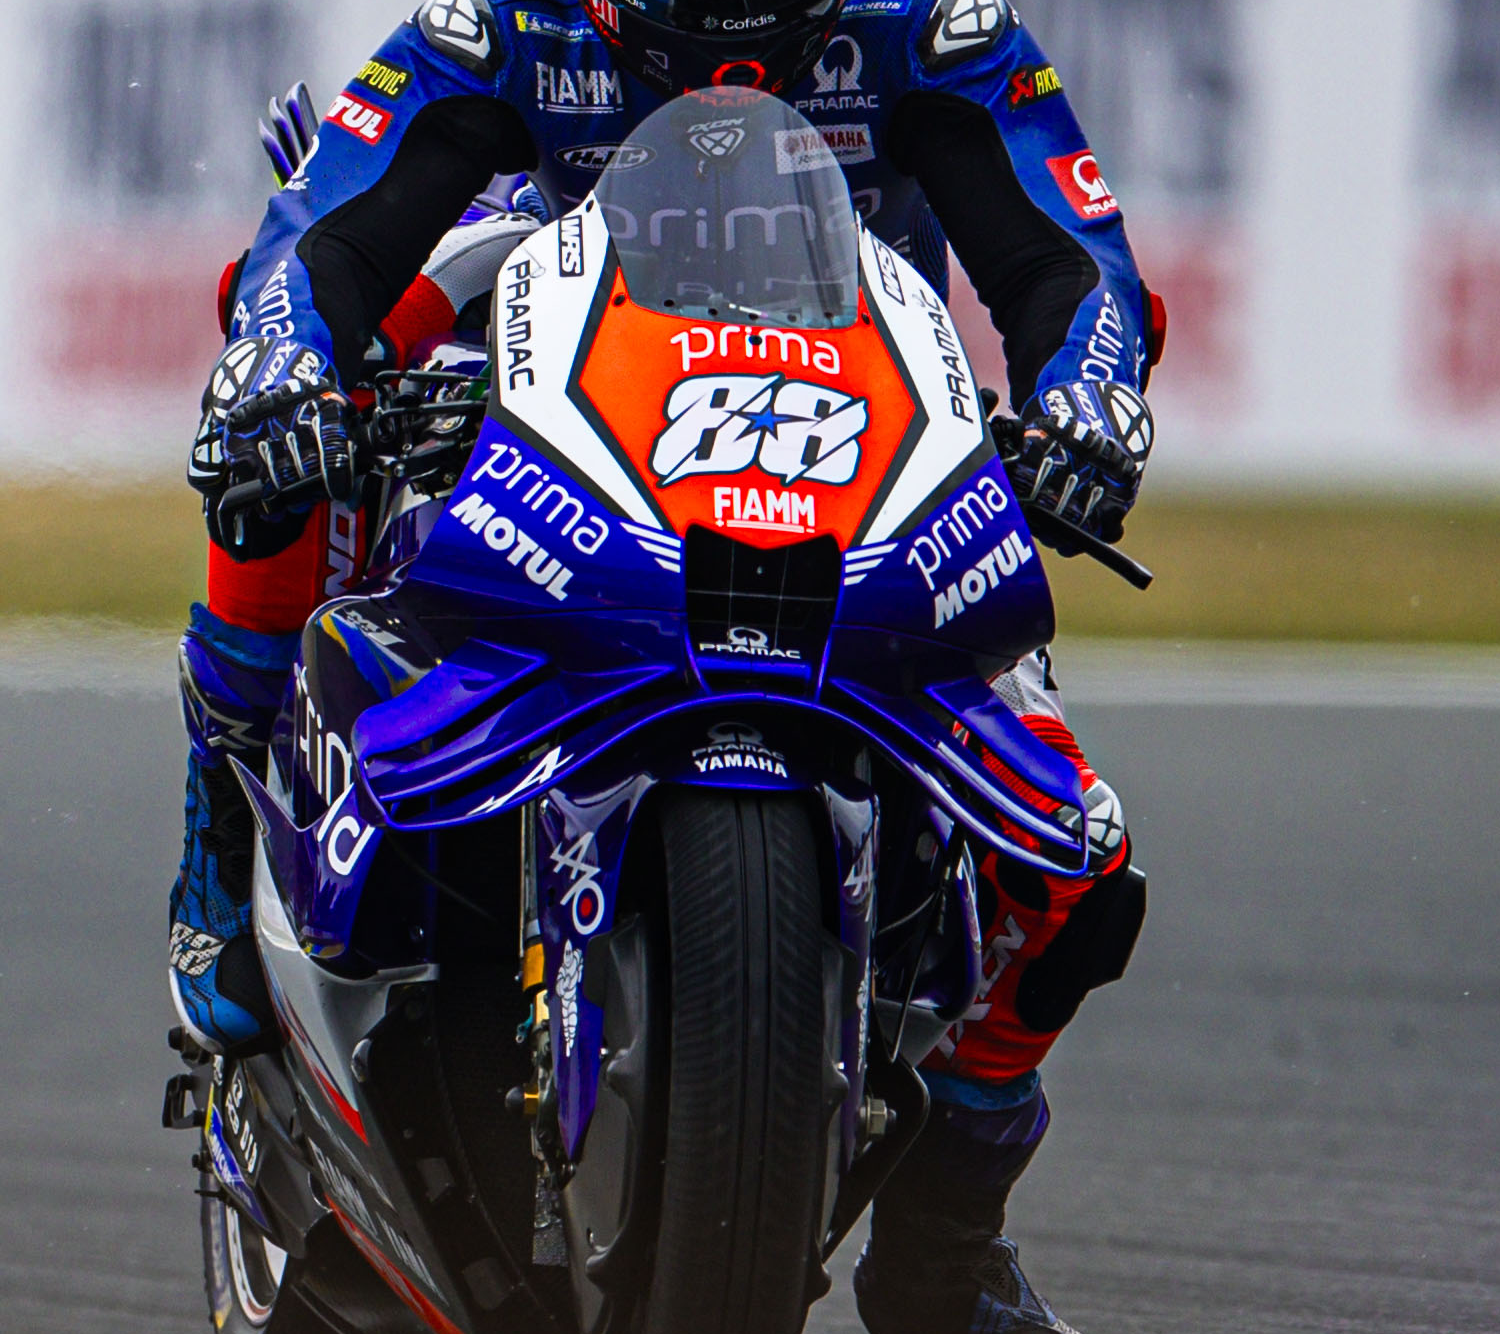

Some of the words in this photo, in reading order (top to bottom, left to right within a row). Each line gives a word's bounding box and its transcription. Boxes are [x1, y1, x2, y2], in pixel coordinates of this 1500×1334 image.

[722, 12, 777, 31] Cofidis
[536, 61, 624, 105] FIAMM
[795, 95, 880, 114] PRAMAC
[800, 130, 867, 152] YAMAHA
[563, 219, 582, 274] WRS
[507, 259, 535, 391] PRAMAC
[670, 325, 841, 375] prima
[919, 288, 974, 424] PRAMAC
[650, 372, 869, 488] 88
[471, 442, 610, 556] prima
[713, 486, 816, 528] FIAMM
[449, 492, 575, 602] MOTUL
[906, 476, 1009, 591] prima
[934, 529, 1033, 630] MOTUL
[698, 642, 802, 660] PRAMAC
[691, 742, 785, 761] PRAMAC
[694, 753, 789, 779] YAMAHA
